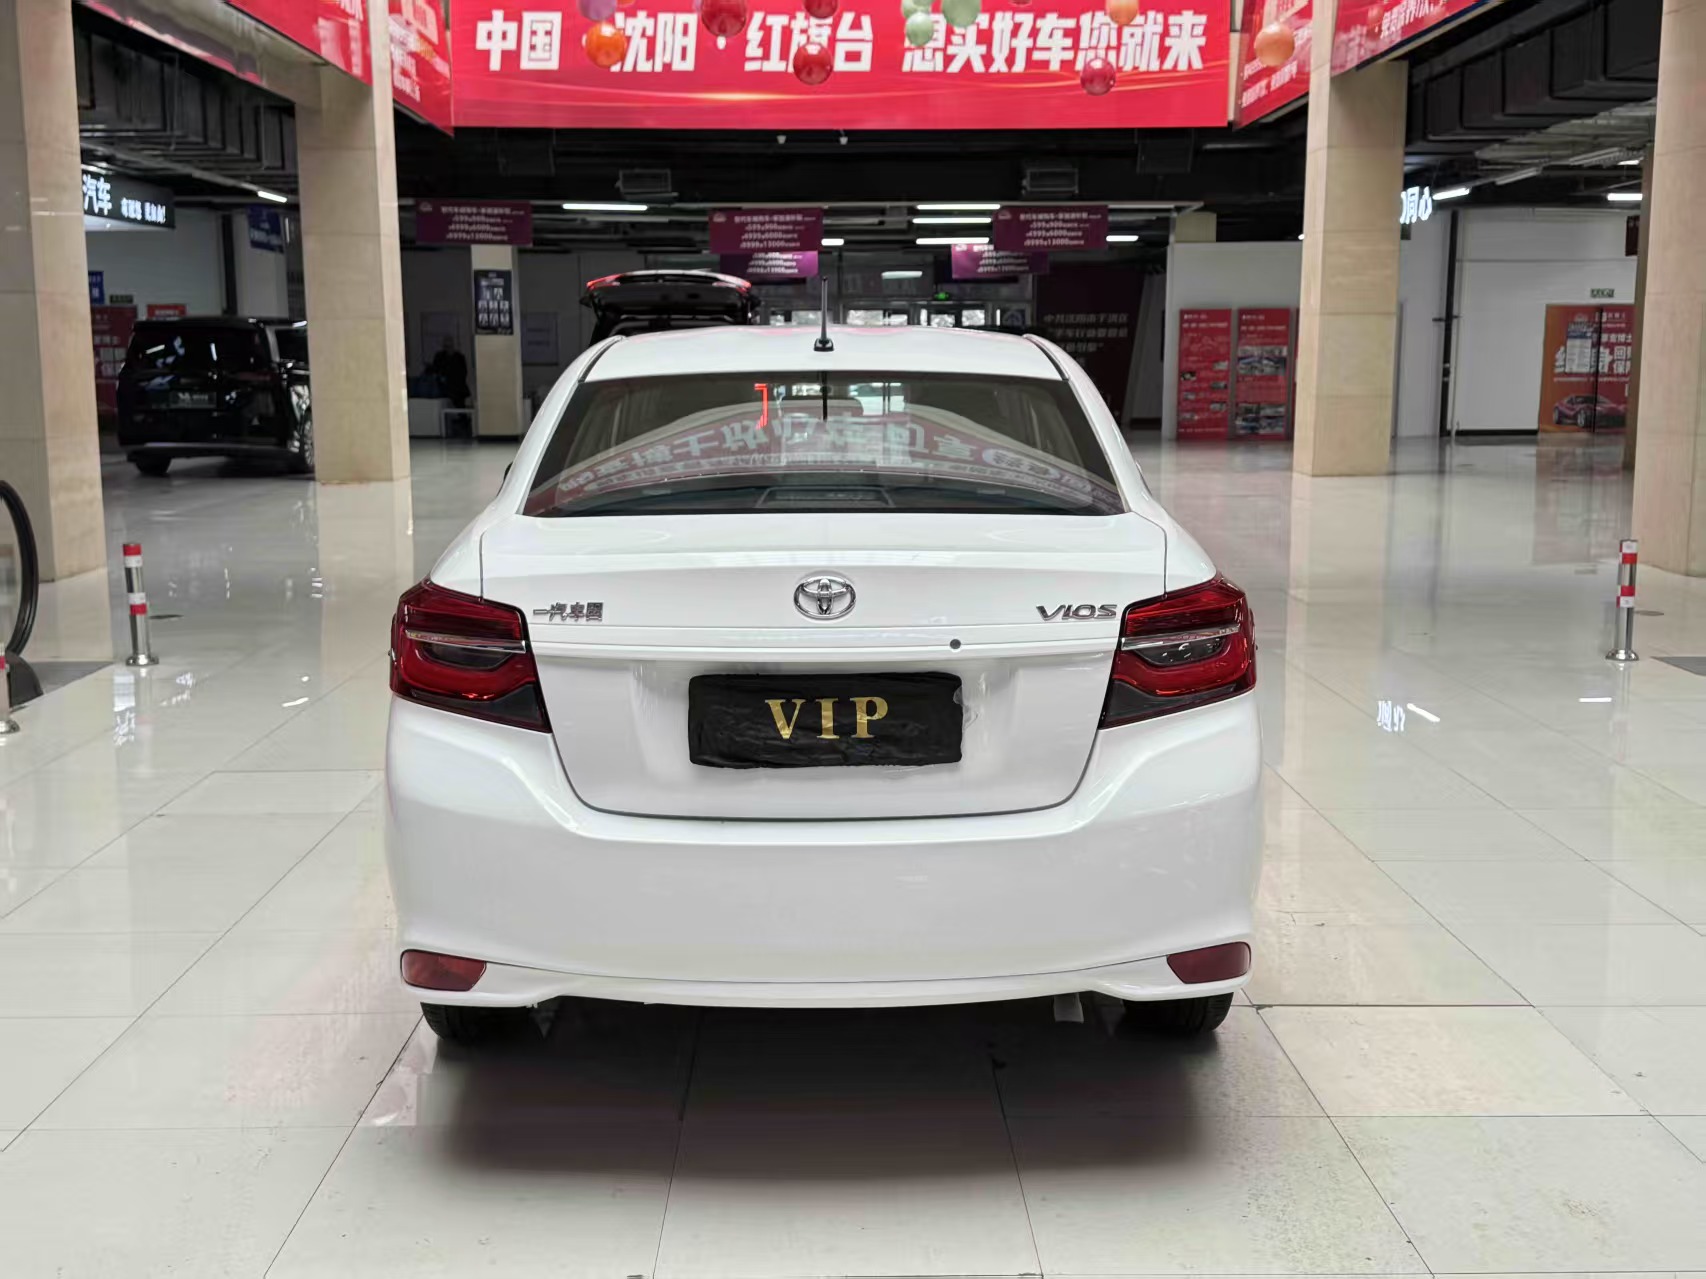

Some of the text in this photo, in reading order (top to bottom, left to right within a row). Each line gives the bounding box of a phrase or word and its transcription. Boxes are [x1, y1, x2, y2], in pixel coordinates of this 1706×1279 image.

[476, 10, 562, 71] 中国
[610, 11, 698, 72] 沈阳
[1036, 604, 1118, 621] VIOS
[765, 696, 889, 740] VIP
